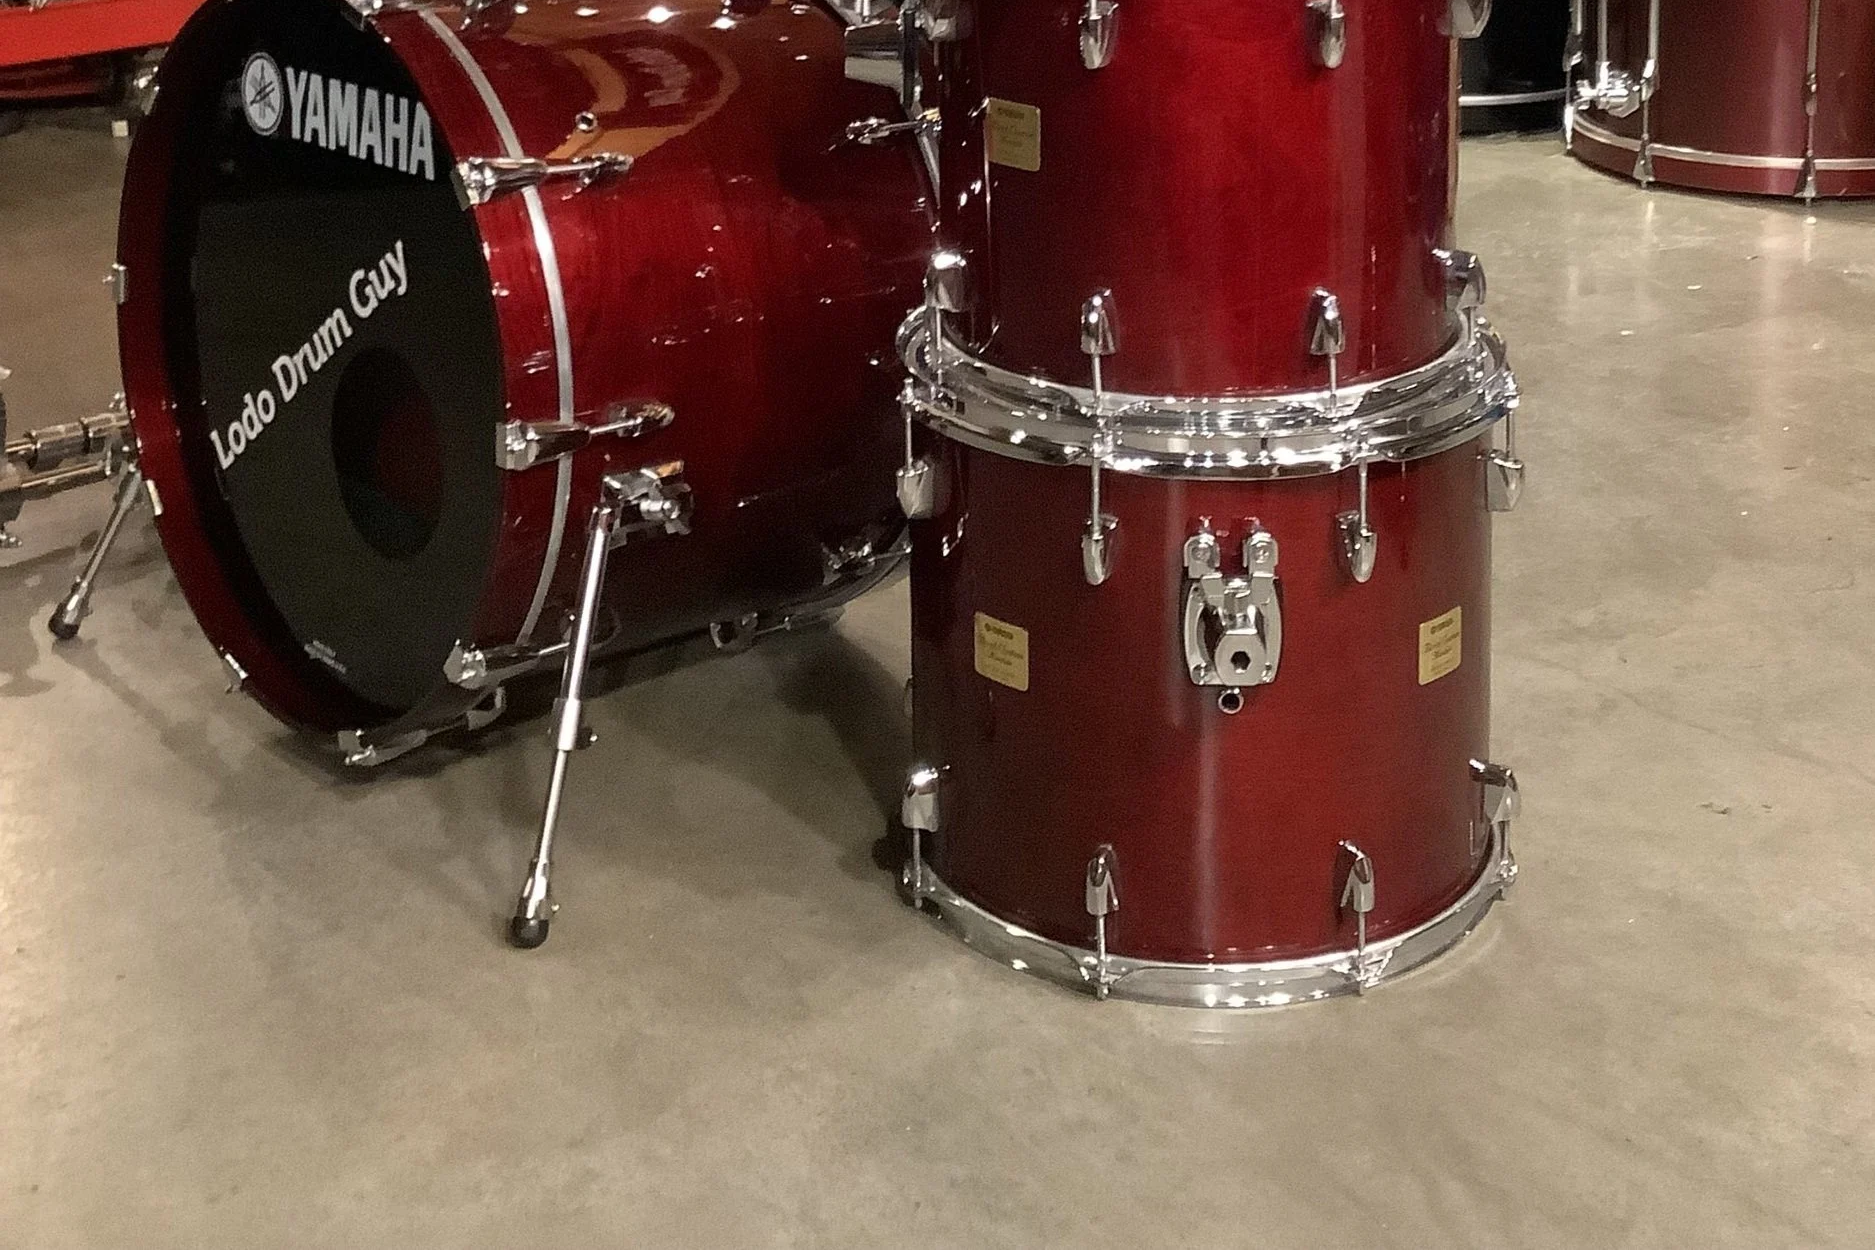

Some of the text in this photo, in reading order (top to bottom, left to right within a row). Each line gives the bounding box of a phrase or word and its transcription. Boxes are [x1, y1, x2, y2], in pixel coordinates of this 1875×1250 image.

[285, 66, 435, 181] YAMAHA
[209, 239, 408, 470] Lodo Drum Guy
